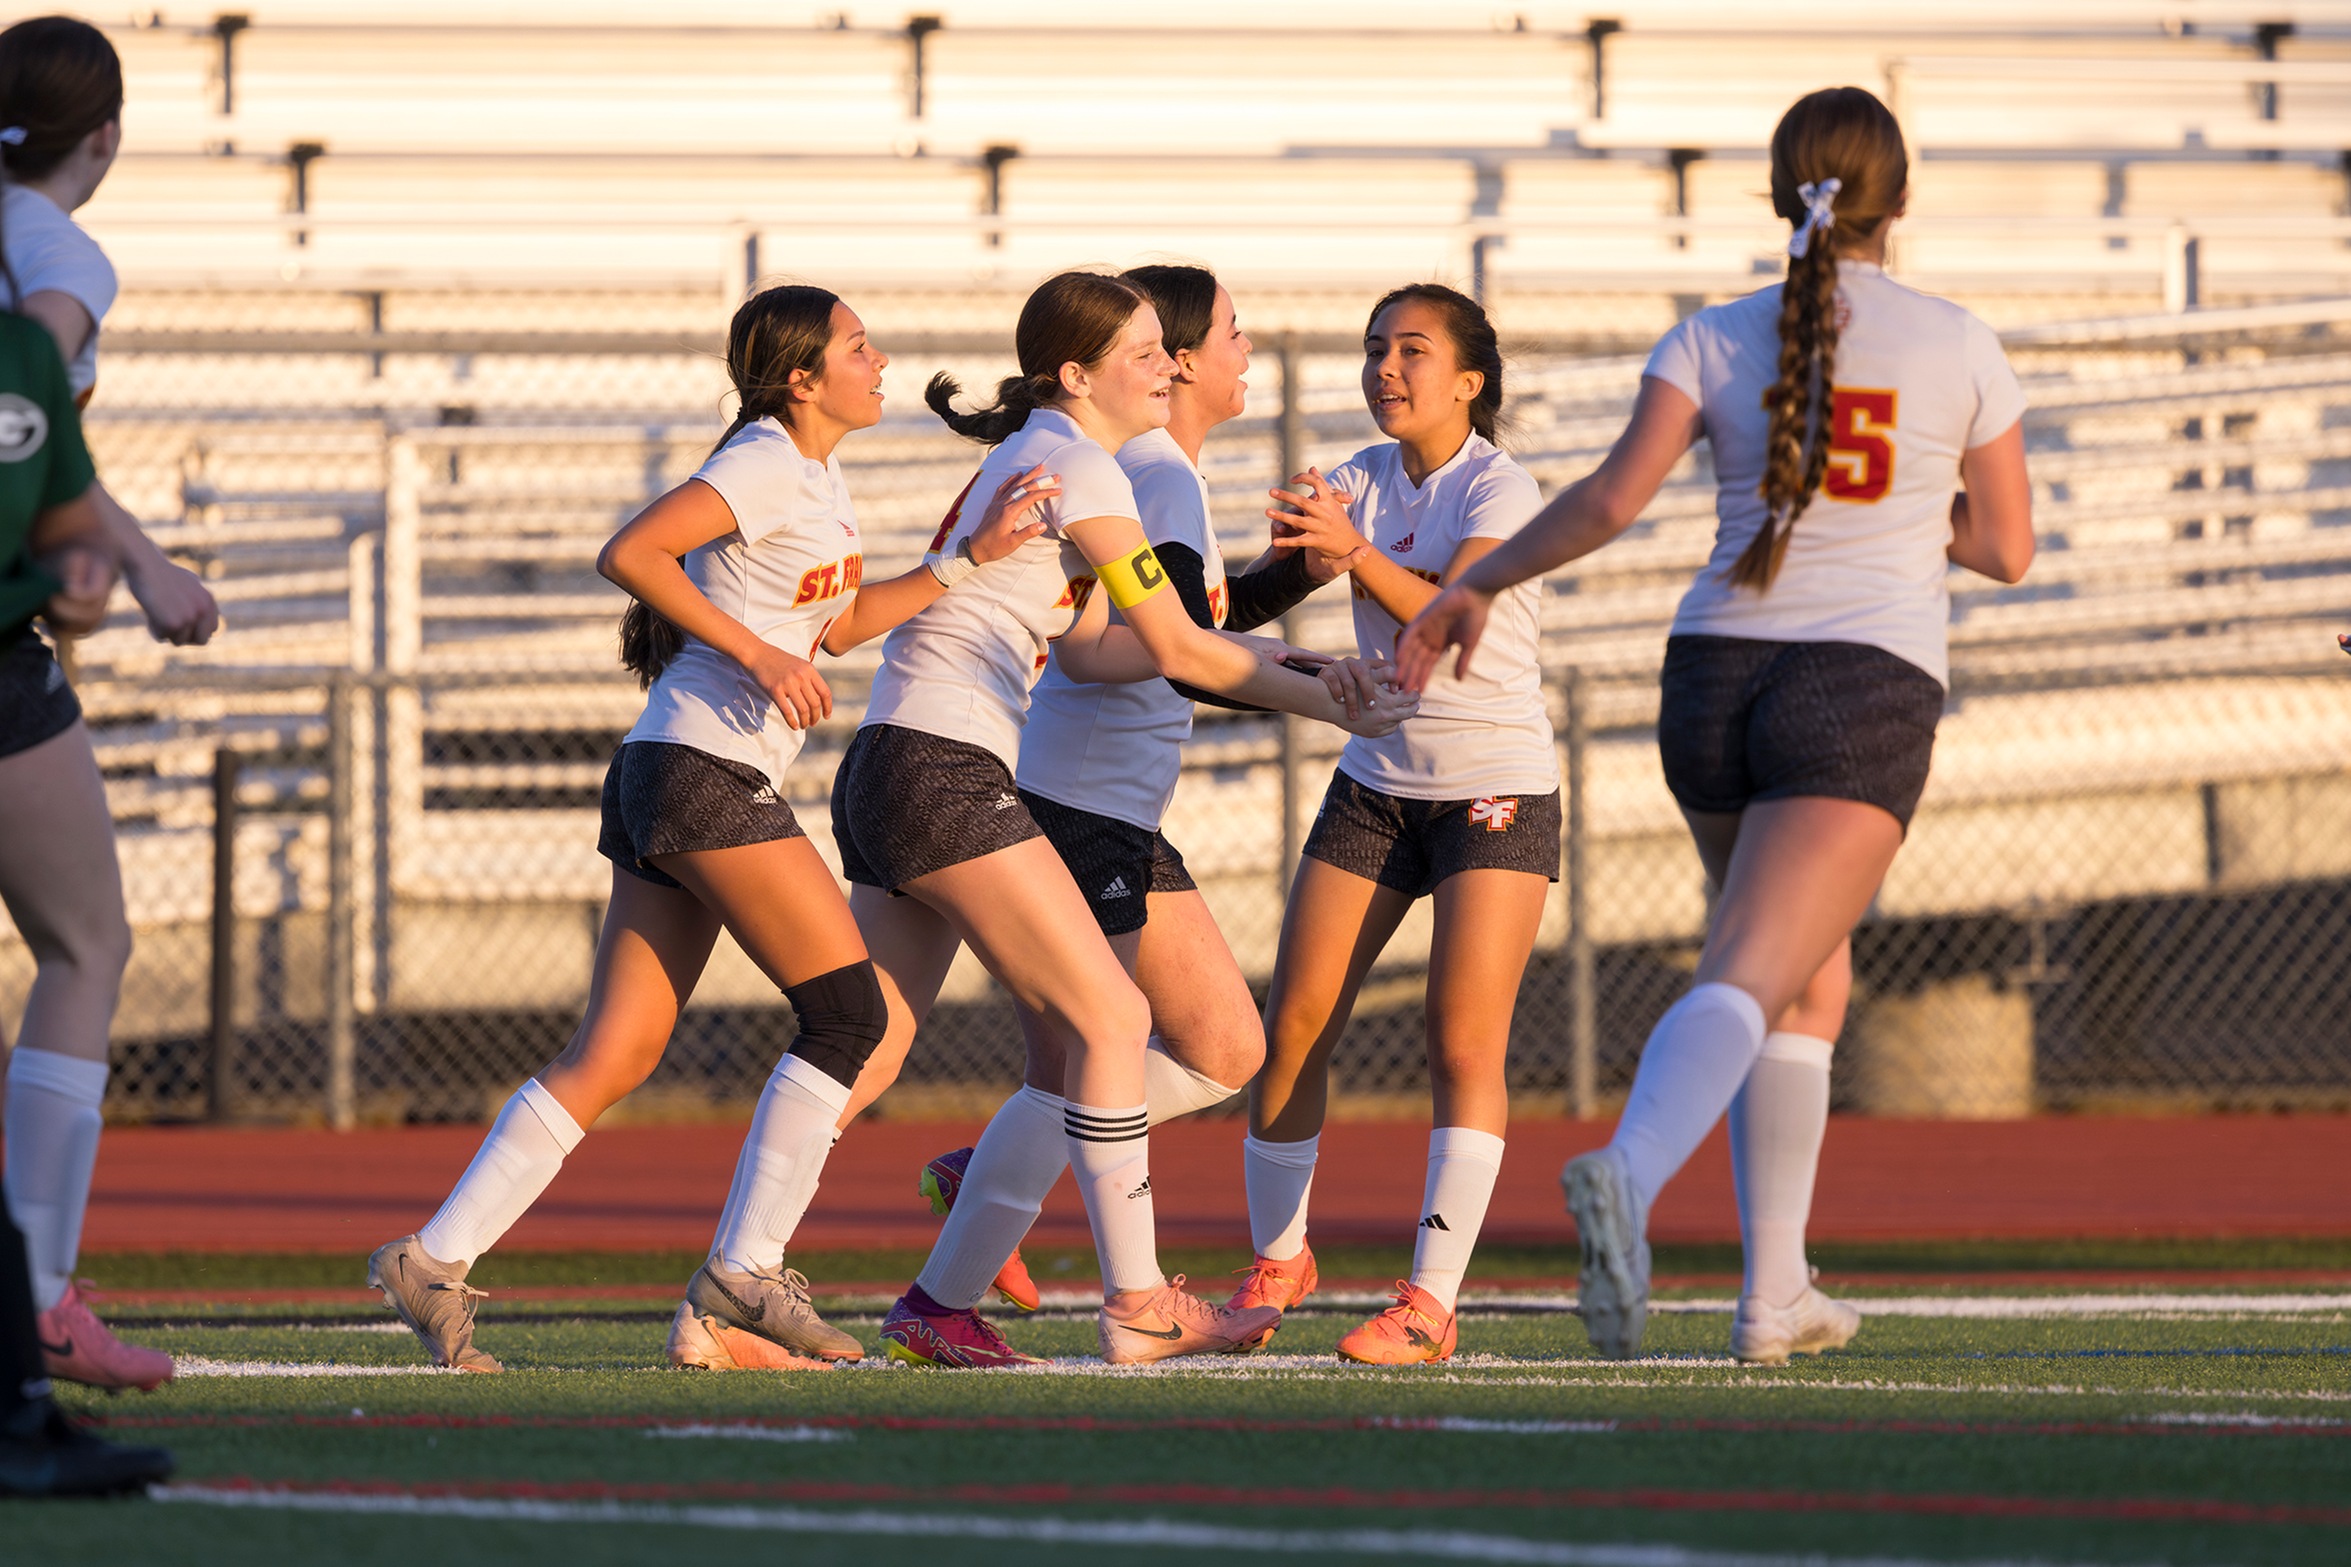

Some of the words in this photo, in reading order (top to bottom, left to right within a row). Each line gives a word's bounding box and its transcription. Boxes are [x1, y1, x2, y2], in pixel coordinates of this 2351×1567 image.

[791, 560, 840, 609] ST.
[1131, 548, 1163, 590] C
[1100, 888, 1131, 900] adidas
